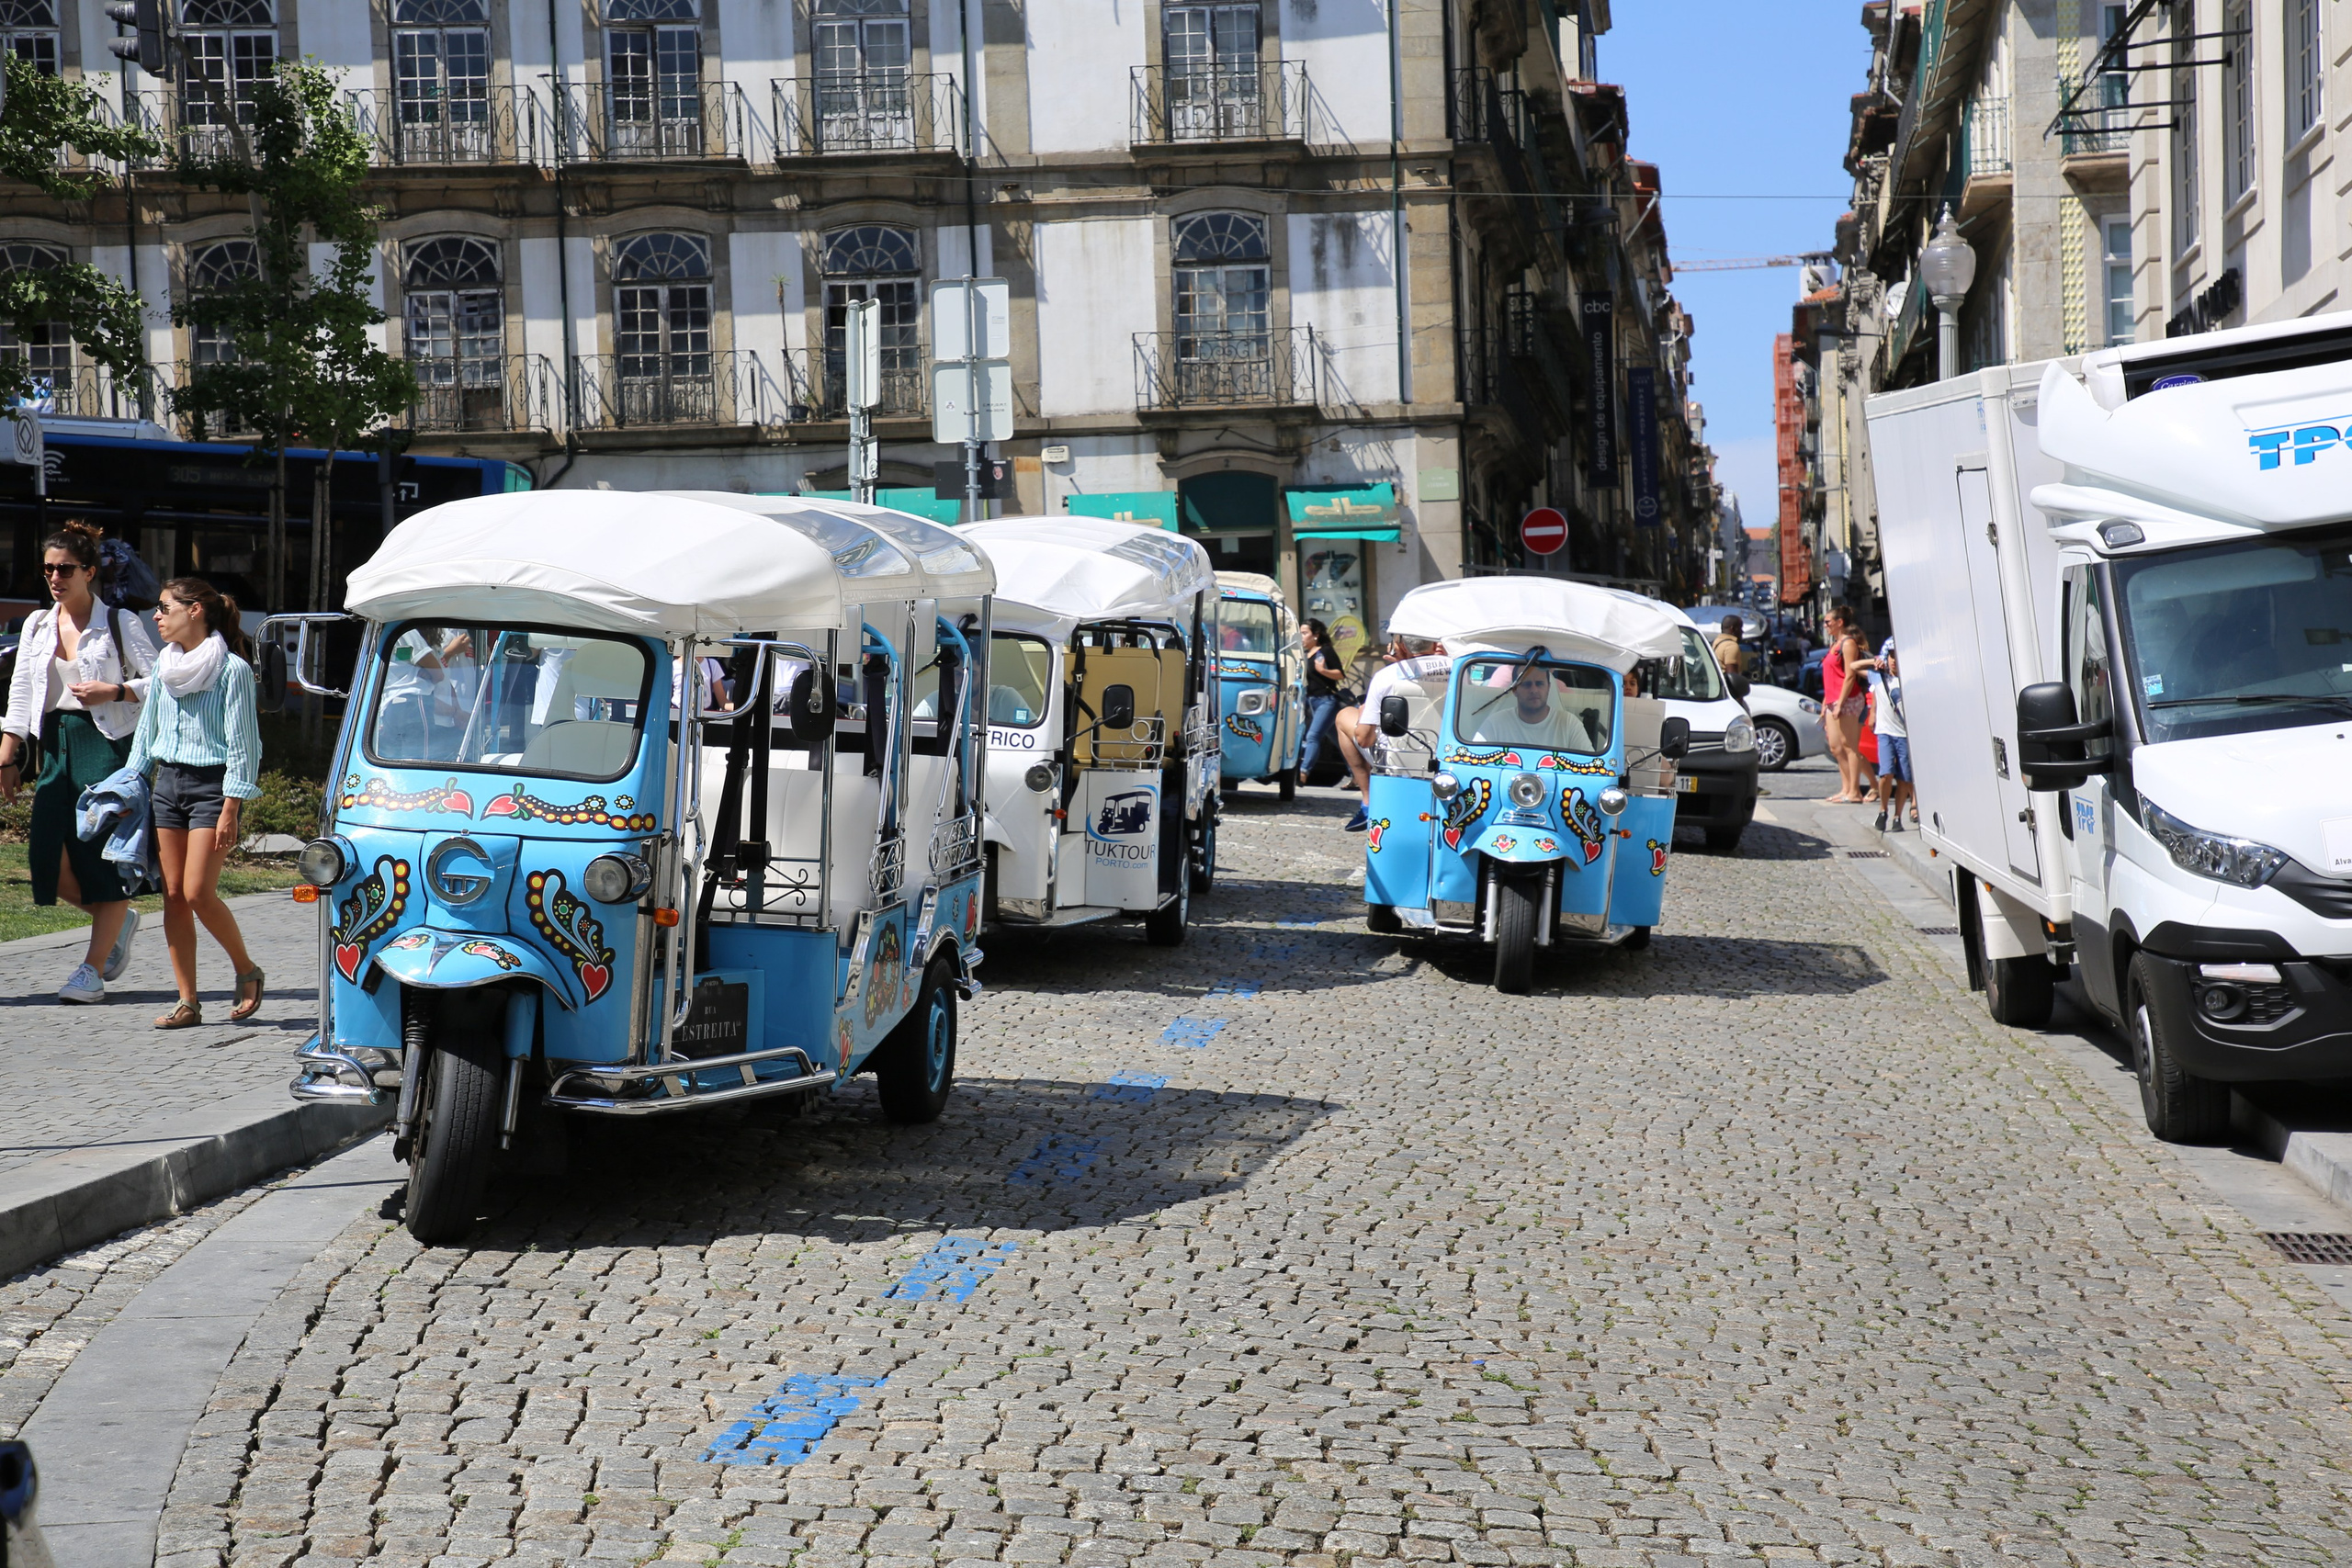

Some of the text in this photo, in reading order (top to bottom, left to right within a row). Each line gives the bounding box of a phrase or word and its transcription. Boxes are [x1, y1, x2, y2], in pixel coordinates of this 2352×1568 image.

[1584, 299, 1611, 313] cbc
[1592, 331, 1609, 471] design de equipamento
[2248, 423, 2352, 471] TP
[170, 466, 200, 483] 305
[1426, 660, 1448, 671] BOAT
[988, 730, 1035, 749] RICO
[1085, 840, 1156, 860] TUKTOUR
[1095, 857, 1148, 869] PORTO.com
[704, 1006, 717, 1015] RUA
[682, 1021, 737, 1042] ESTREITA
